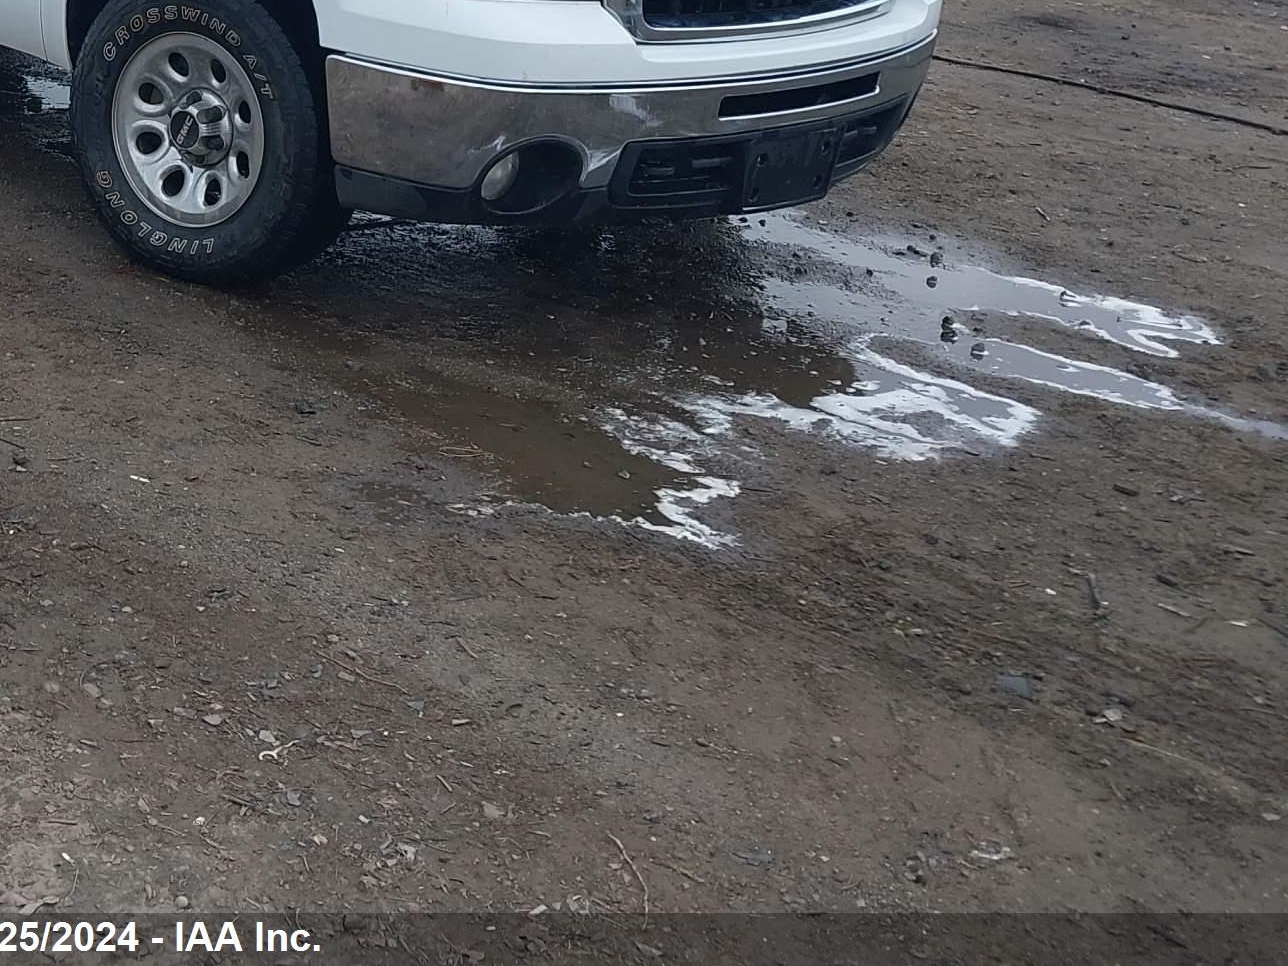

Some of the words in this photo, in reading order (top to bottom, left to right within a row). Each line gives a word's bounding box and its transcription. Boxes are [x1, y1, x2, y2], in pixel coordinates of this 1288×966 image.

[103, 4, 241, 62] CROSSWIND
[242, 53, 274, 100] A/T
[176, 114, 195, 145] GMC
[96, 170, 216, 254] LINGLONG
